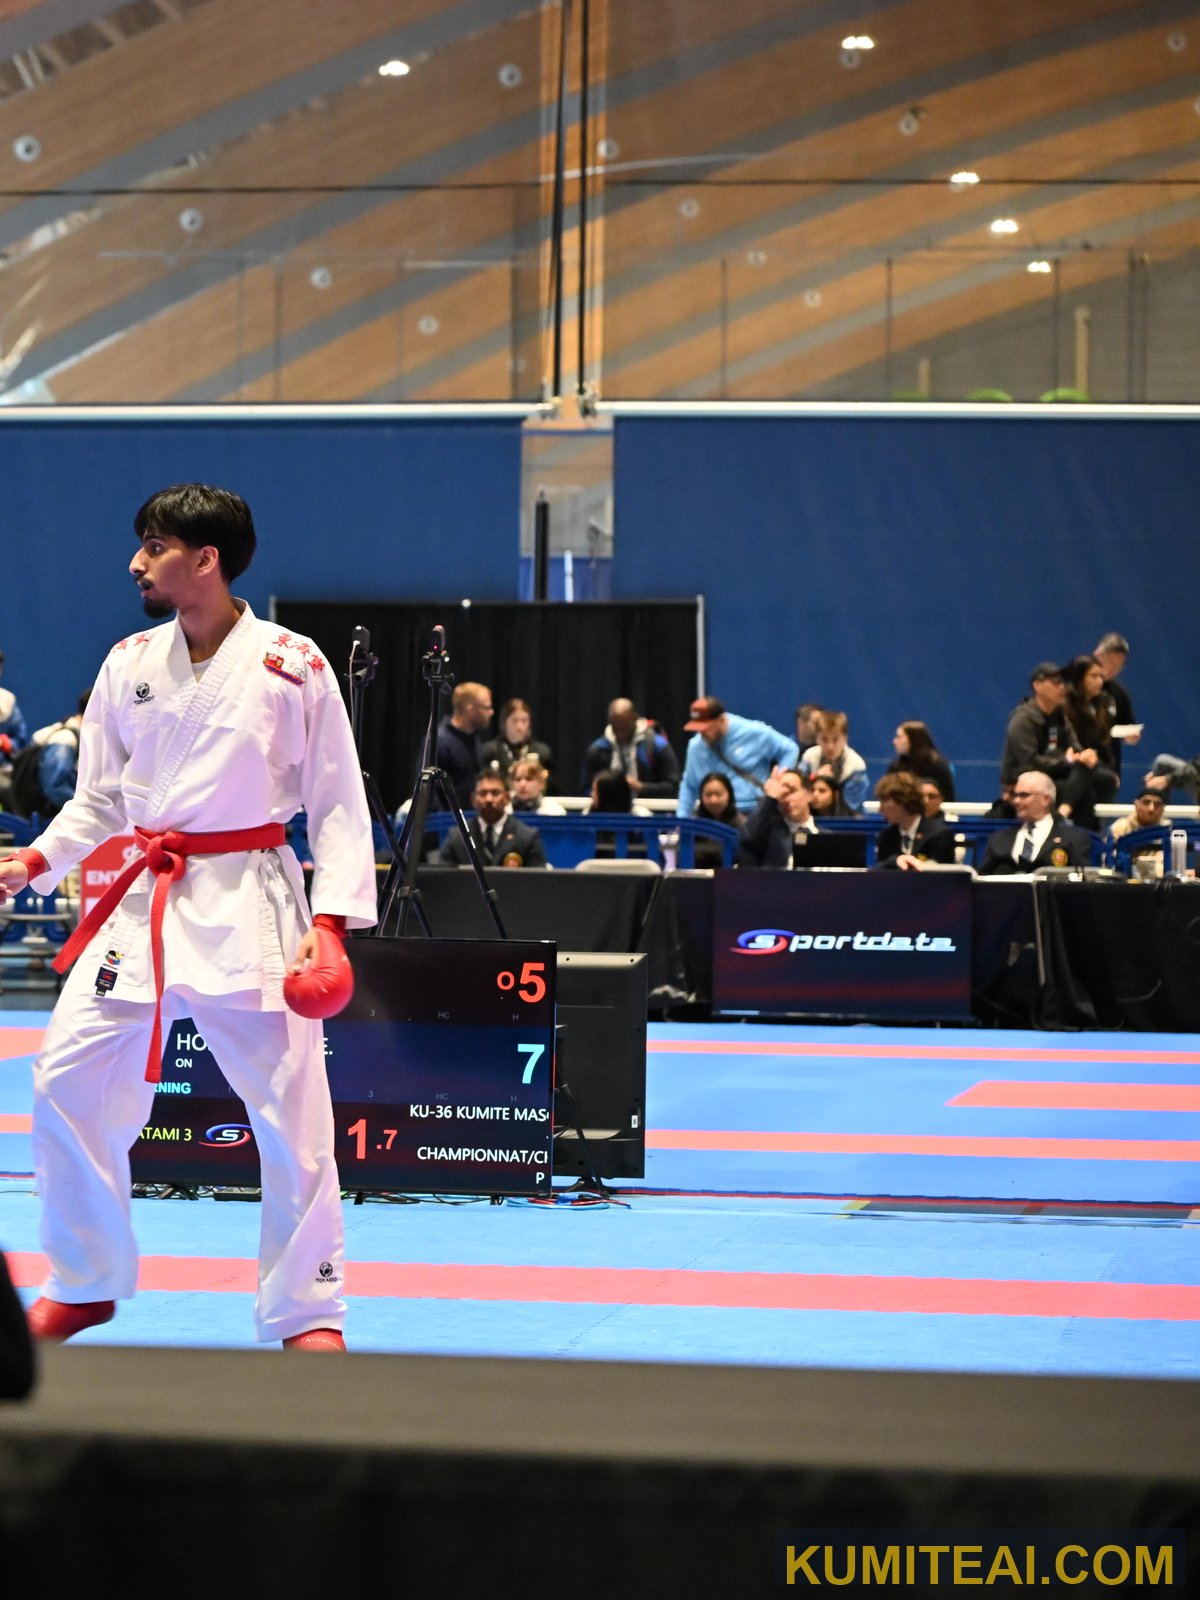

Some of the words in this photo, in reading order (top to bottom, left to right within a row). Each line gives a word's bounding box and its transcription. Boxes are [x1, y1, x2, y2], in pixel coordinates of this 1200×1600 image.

[518, 962, 546, 1004] 5
[176, 1033, 211, 1052] HO
[175, 1058, 193, 1068] ON
[517, 1043, 545, 1084] 7
[410, 1104, 452, 1119] KU-36
[456, 1105, 510, 1121] KUMITE
[514, 1107, 549, 1122] MAS
[183, 1128, 193, 1142] 3
